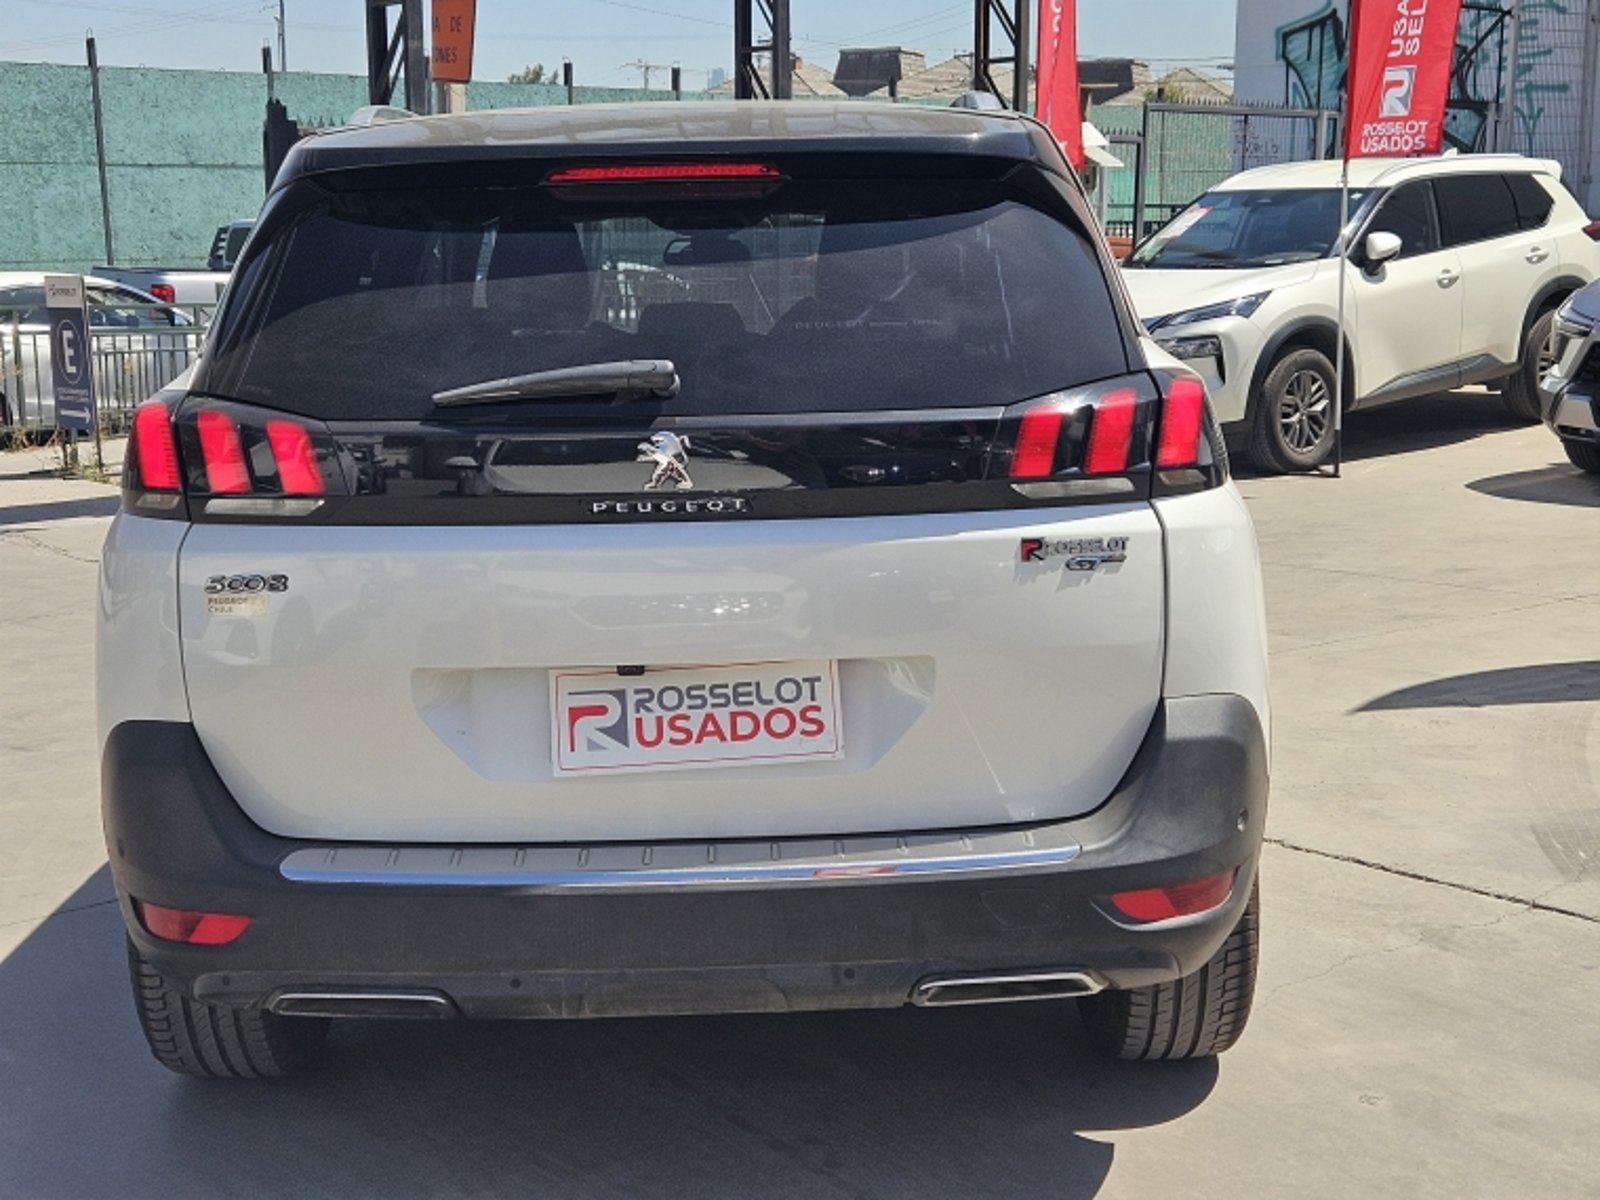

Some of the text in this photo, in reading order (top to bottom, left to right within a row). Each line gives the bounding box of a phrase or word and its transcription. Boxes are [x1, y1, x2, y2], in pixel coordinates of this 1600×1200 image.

[1362, 121, 1429, 136] ROSSELOT
[1360, 136, 1426, 152] USADOS
[62, 329, 77, 374] E
[592, 498, 746, 513] PEUGEOT
[204, 574, 289, 594] 5008
[633, 676, 822, 714] ROSSELOT
[635, 704, 826, 748] USADOS
